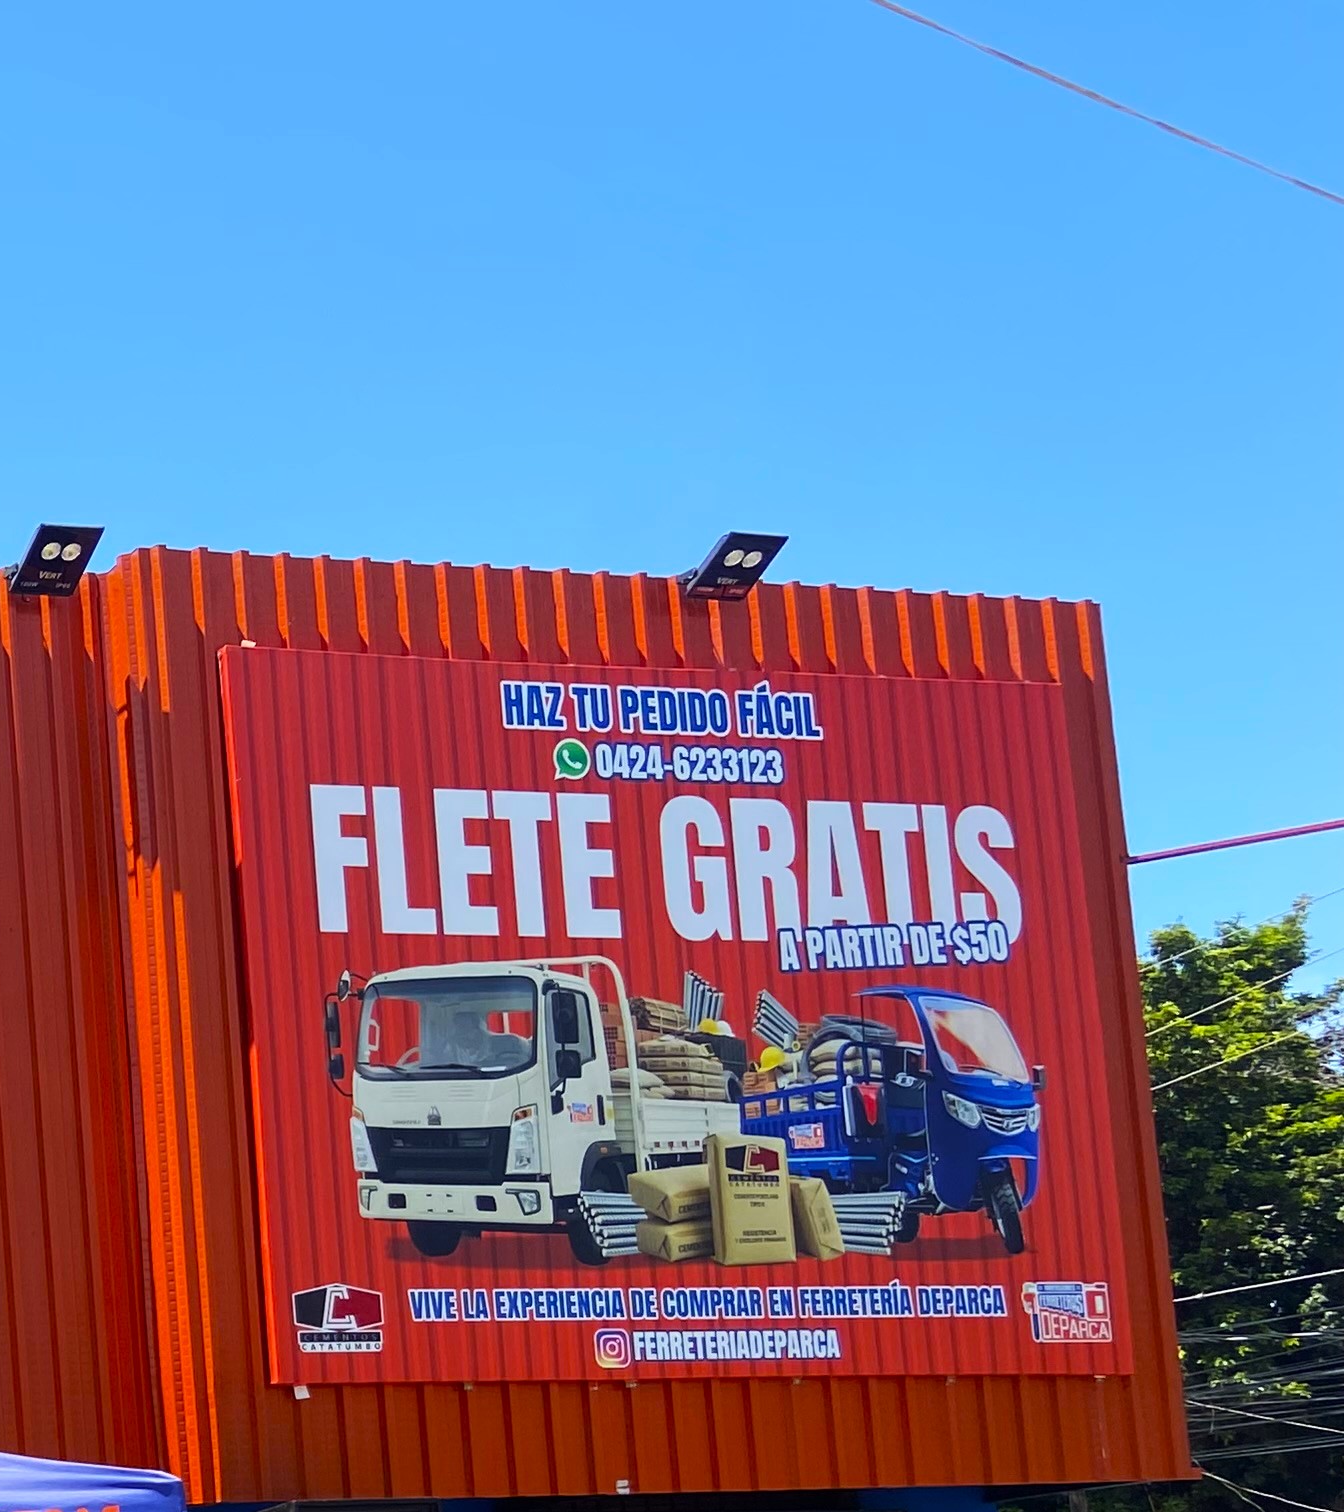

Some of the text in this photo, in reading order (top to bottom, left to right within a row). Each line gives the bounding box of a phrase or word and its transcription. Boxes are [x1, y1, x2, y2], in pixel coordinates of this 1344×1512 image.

[503, 682, 820, 738] HAZ TU PEDIDO FÁCIL
[595, 743, 785, 784] 0424-6233123
[309, 784, 1024, 943] FLETE GRATIS
[778, 919, 1009, 971] A PARTIR DE $50
[409, 1289, 458, 1320] VIVE
[462, 1290, 489, 1320] LA
[494, 1289, 626, 1319] EXPERIENCIA
[631, 1288, 657, 1318] DE
[662, 1287, 763, 1318] COMPRAR
[769, 1287, 793, 1317] EN
[799, 1279, 913, 1316] FERRETERÍA
[918, 1286, 1006, 1315] DEPARCA
[303, 1333, 379, 1342] CEMENTOS
[632, 1329, 841, 1360] FERRETERIADEPARCA
[1041, 1312, 1109, 1339] DEPARCA
[301, 1342, 382, 1351] CATATUMBO
